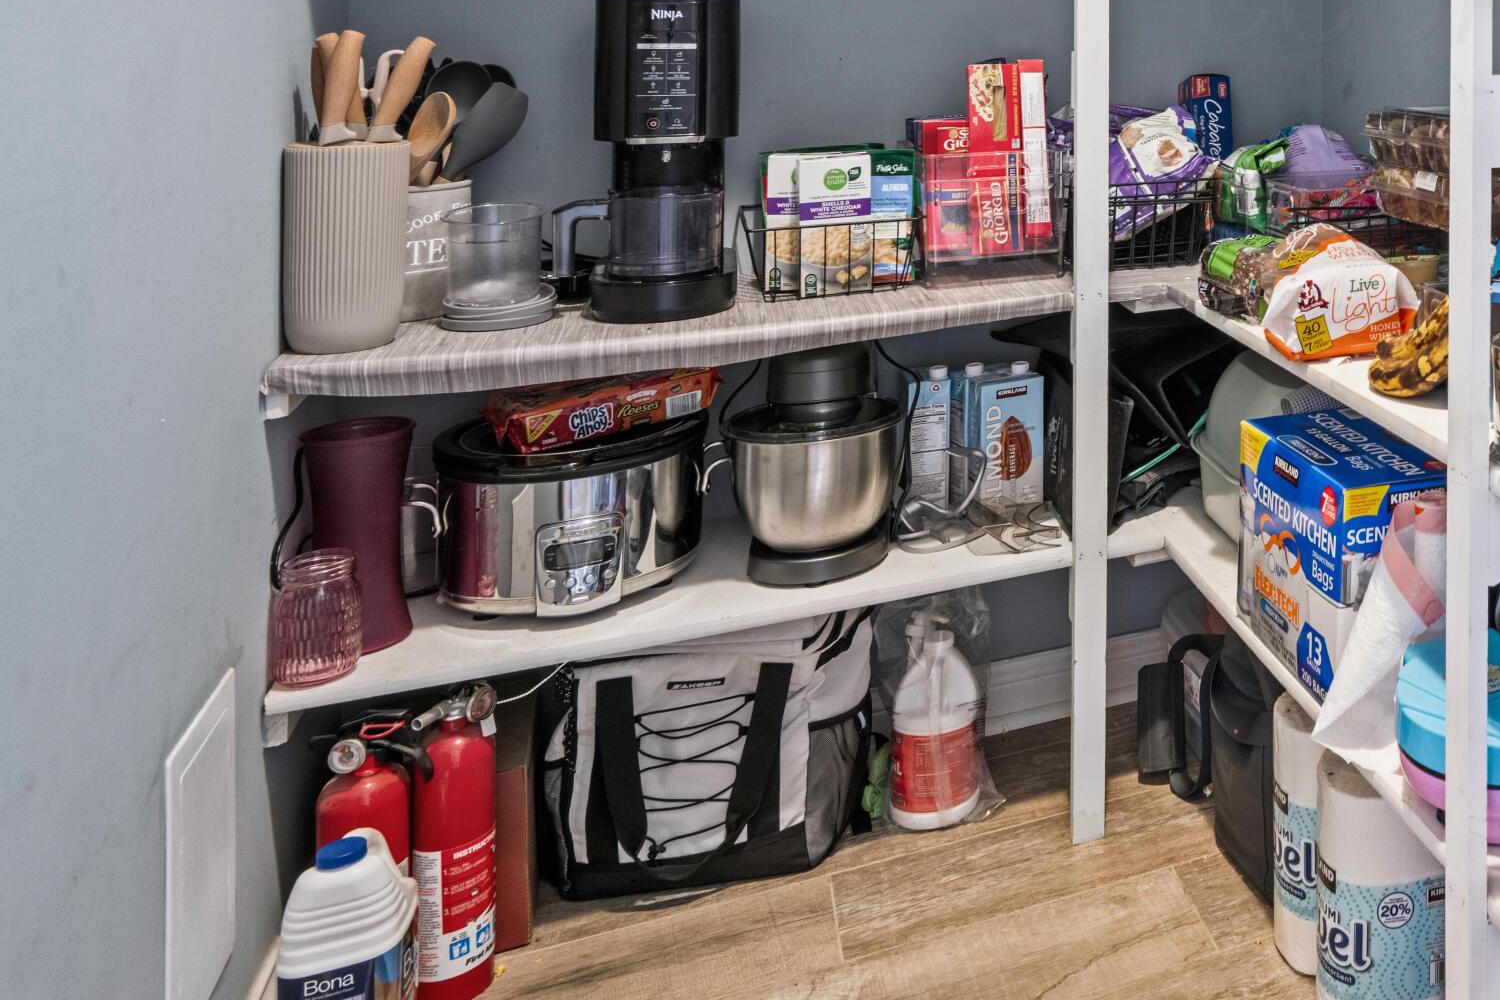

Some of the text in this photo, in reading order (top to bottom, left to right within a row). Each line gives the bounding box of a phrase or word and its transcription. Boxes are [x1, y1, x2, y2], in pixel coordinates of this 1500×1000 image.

[651, 8, 684, 21] NINJA
[1204, 98, 1226, 162] Cabaret
[882, 183, 909, 192] ALFREDO
[810, 203, 861, 213] WHITE CHEDDAR
[983, 200, 994, 227] SAN
[994, 182, 1009, 244] GIORGIO
[1350, 278, 1380, 293] Live
[1332, 276, 1397, 331] Light
[1303, 321, 1320, 336] 40
[1303, 331, 1326, 341] Calories
[1370, 321, 1401, 333] HONEY
[1304, 341, 1312, 351] 7
[997, 385, 1027, 397] KIRKLAND
[570, 406, 606, 429] Chips
[617, 400, 660, 419] Reese's
[575, 404, 613, 439] Ahoy!
[1308, 412, 1426, 476] SCENTED KITCHEN
[1315, 430, 1352, 453] GALLON
[985, 405, 1003, 505] ALMOND
[1345, 456, 1374, 471] Bags
[1274, 455, 1299, 480] KIRKLAND
[1322, 492, 1328, 513] 7
[1253, 477, 1337, 559] SCENTED KITCHEN
[1311, 560, 1334, 591] Bags
[1306, 631, 1322, 667] 13
[1302, 667, 1313, 688] 200
[1380, 903, 1411, 918] 20%
[466, 951, 482, 967] First
[303, 973, 355, 997] Bona
